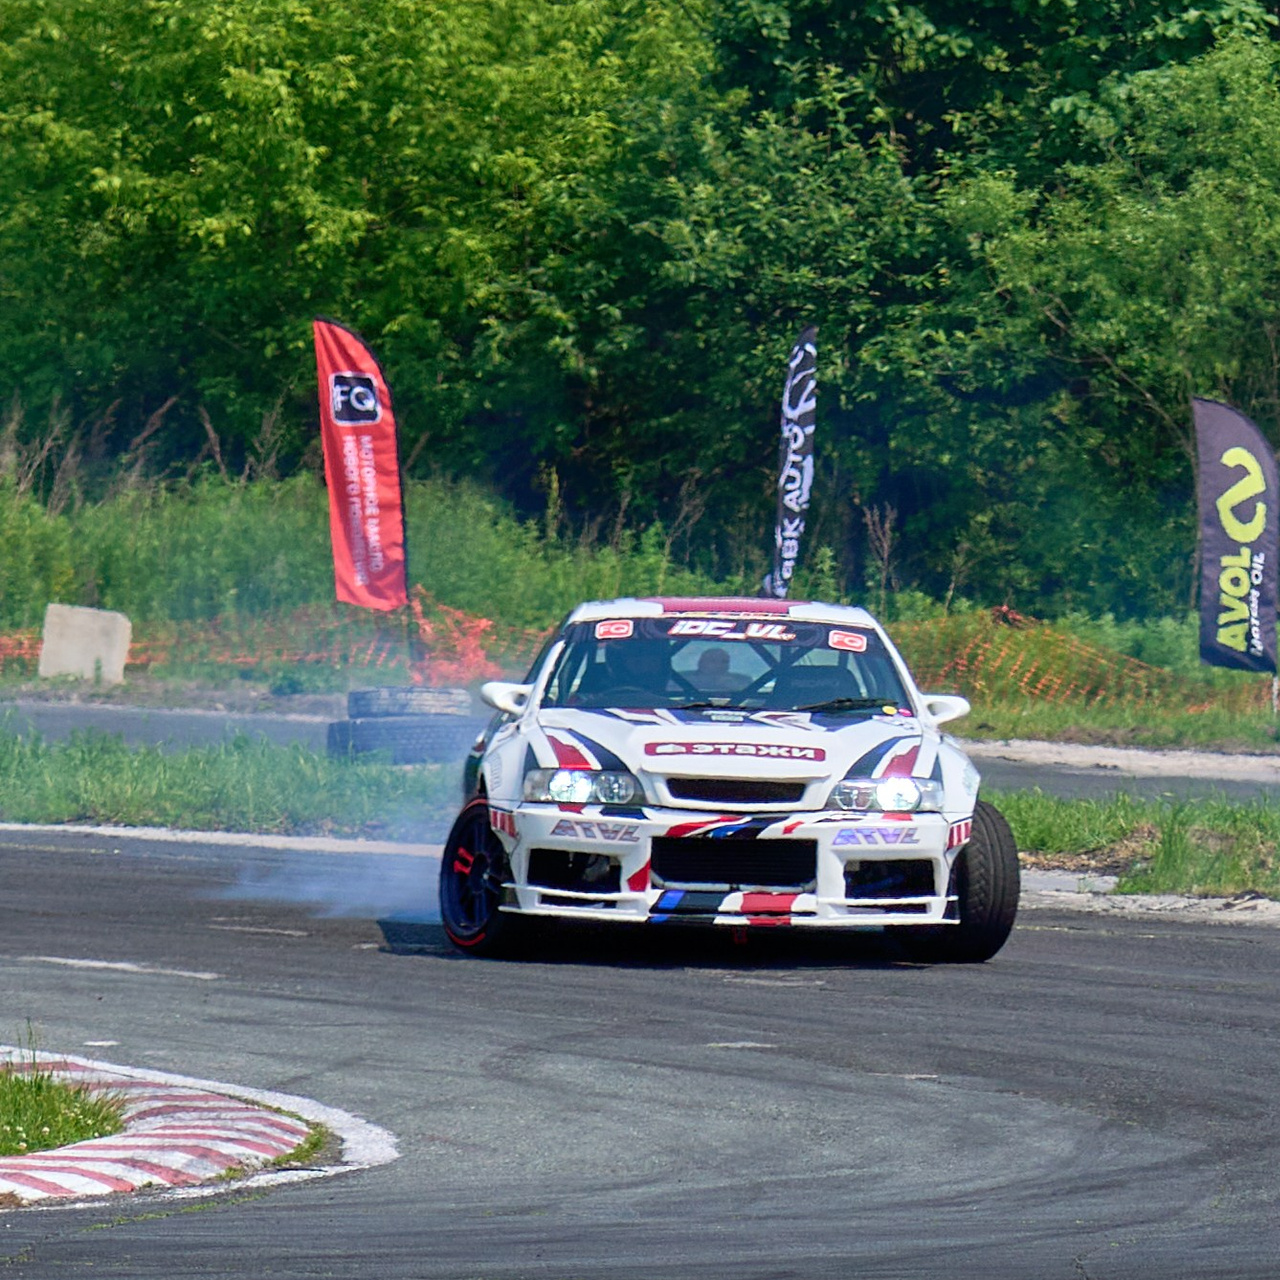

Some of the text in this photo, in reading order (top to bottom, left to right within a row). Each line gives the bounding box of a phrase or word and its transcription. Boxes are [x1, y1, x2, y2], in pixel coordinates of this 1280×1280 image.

[333, 385, 376, 412] FQ
[1250, 552, 1265, 585] OIL
[1216, 546, 1252, 652] AVOL
[598, 622, 630, 637] FQ
[830, 632, 863, 650] FQ
[550, 818, 640, 842] ATVL
[832, 827, 920, 845] ATVL
